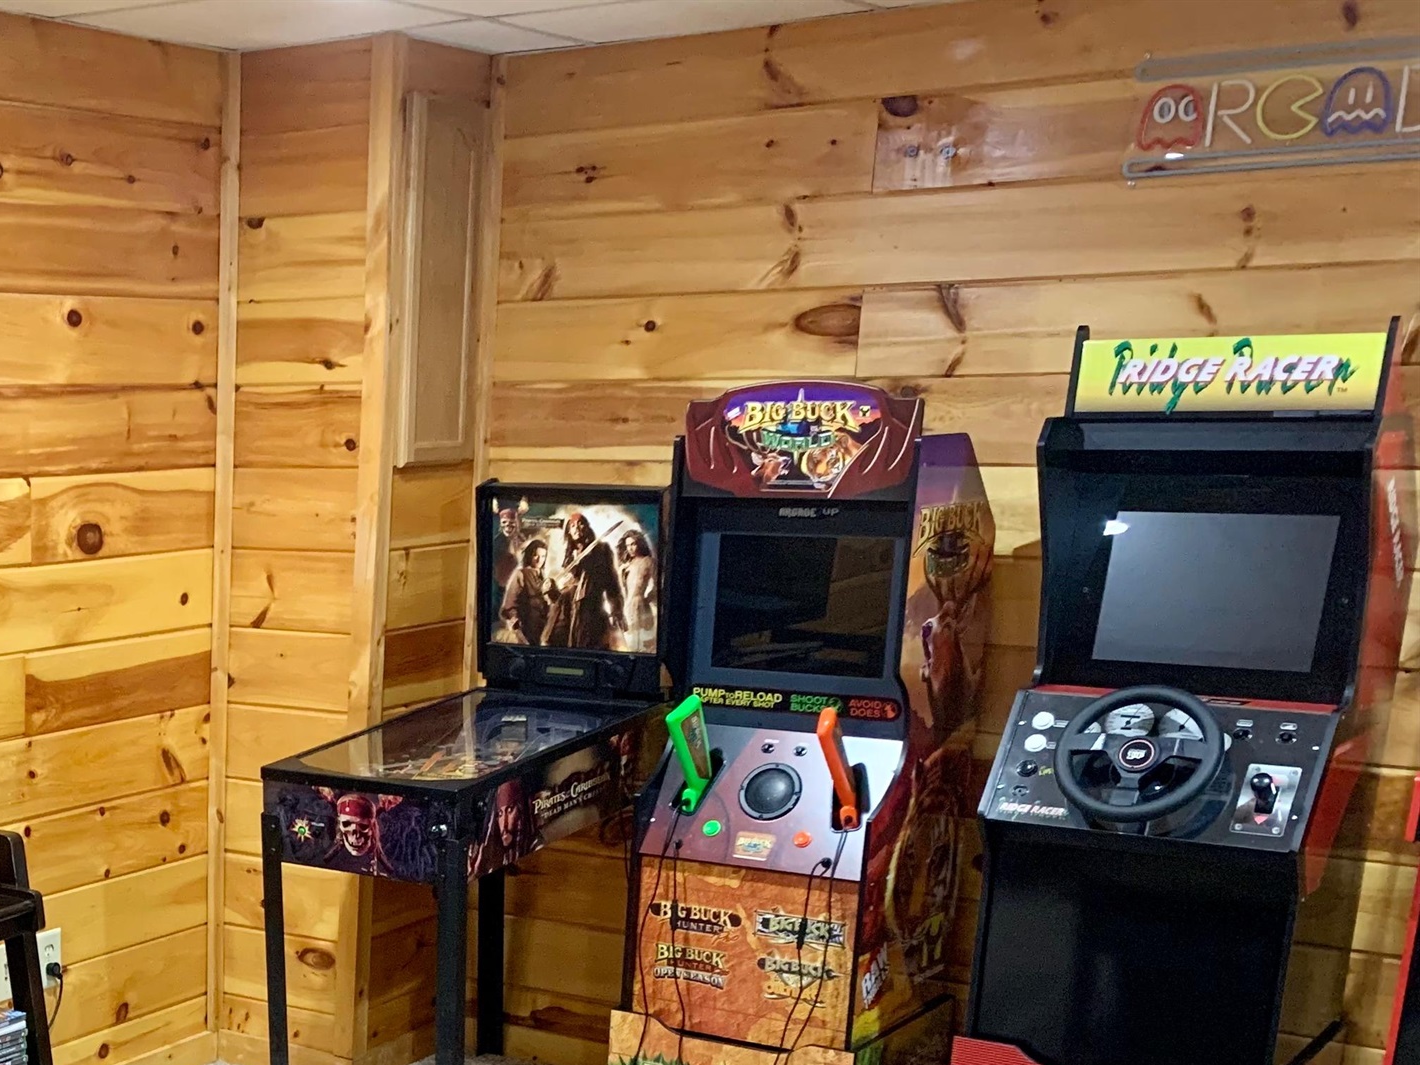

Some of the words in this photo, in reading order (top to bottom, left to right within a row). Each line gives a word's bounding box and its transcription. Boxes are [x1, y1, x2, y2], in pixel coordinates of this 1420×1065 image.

[738, 401, 786, 434] BIG
[791, 400, 861, 433] BUCK
[760, 430, 837, 451] WORLD
[692, 686, 725, 699] PUMP
[734, 689, 783, 704] RELOAD
[790, 694, 828, 706] SHOOT
[848, 699, 881, 710] AVOID
[849, 708, 881, 719] DOES
[660, 901, 687, 918] BG
[689, 906, 732, 929] BUCK
[656, 943, 683, 962] BIG
[685, 948, 725, 969] BUCK
